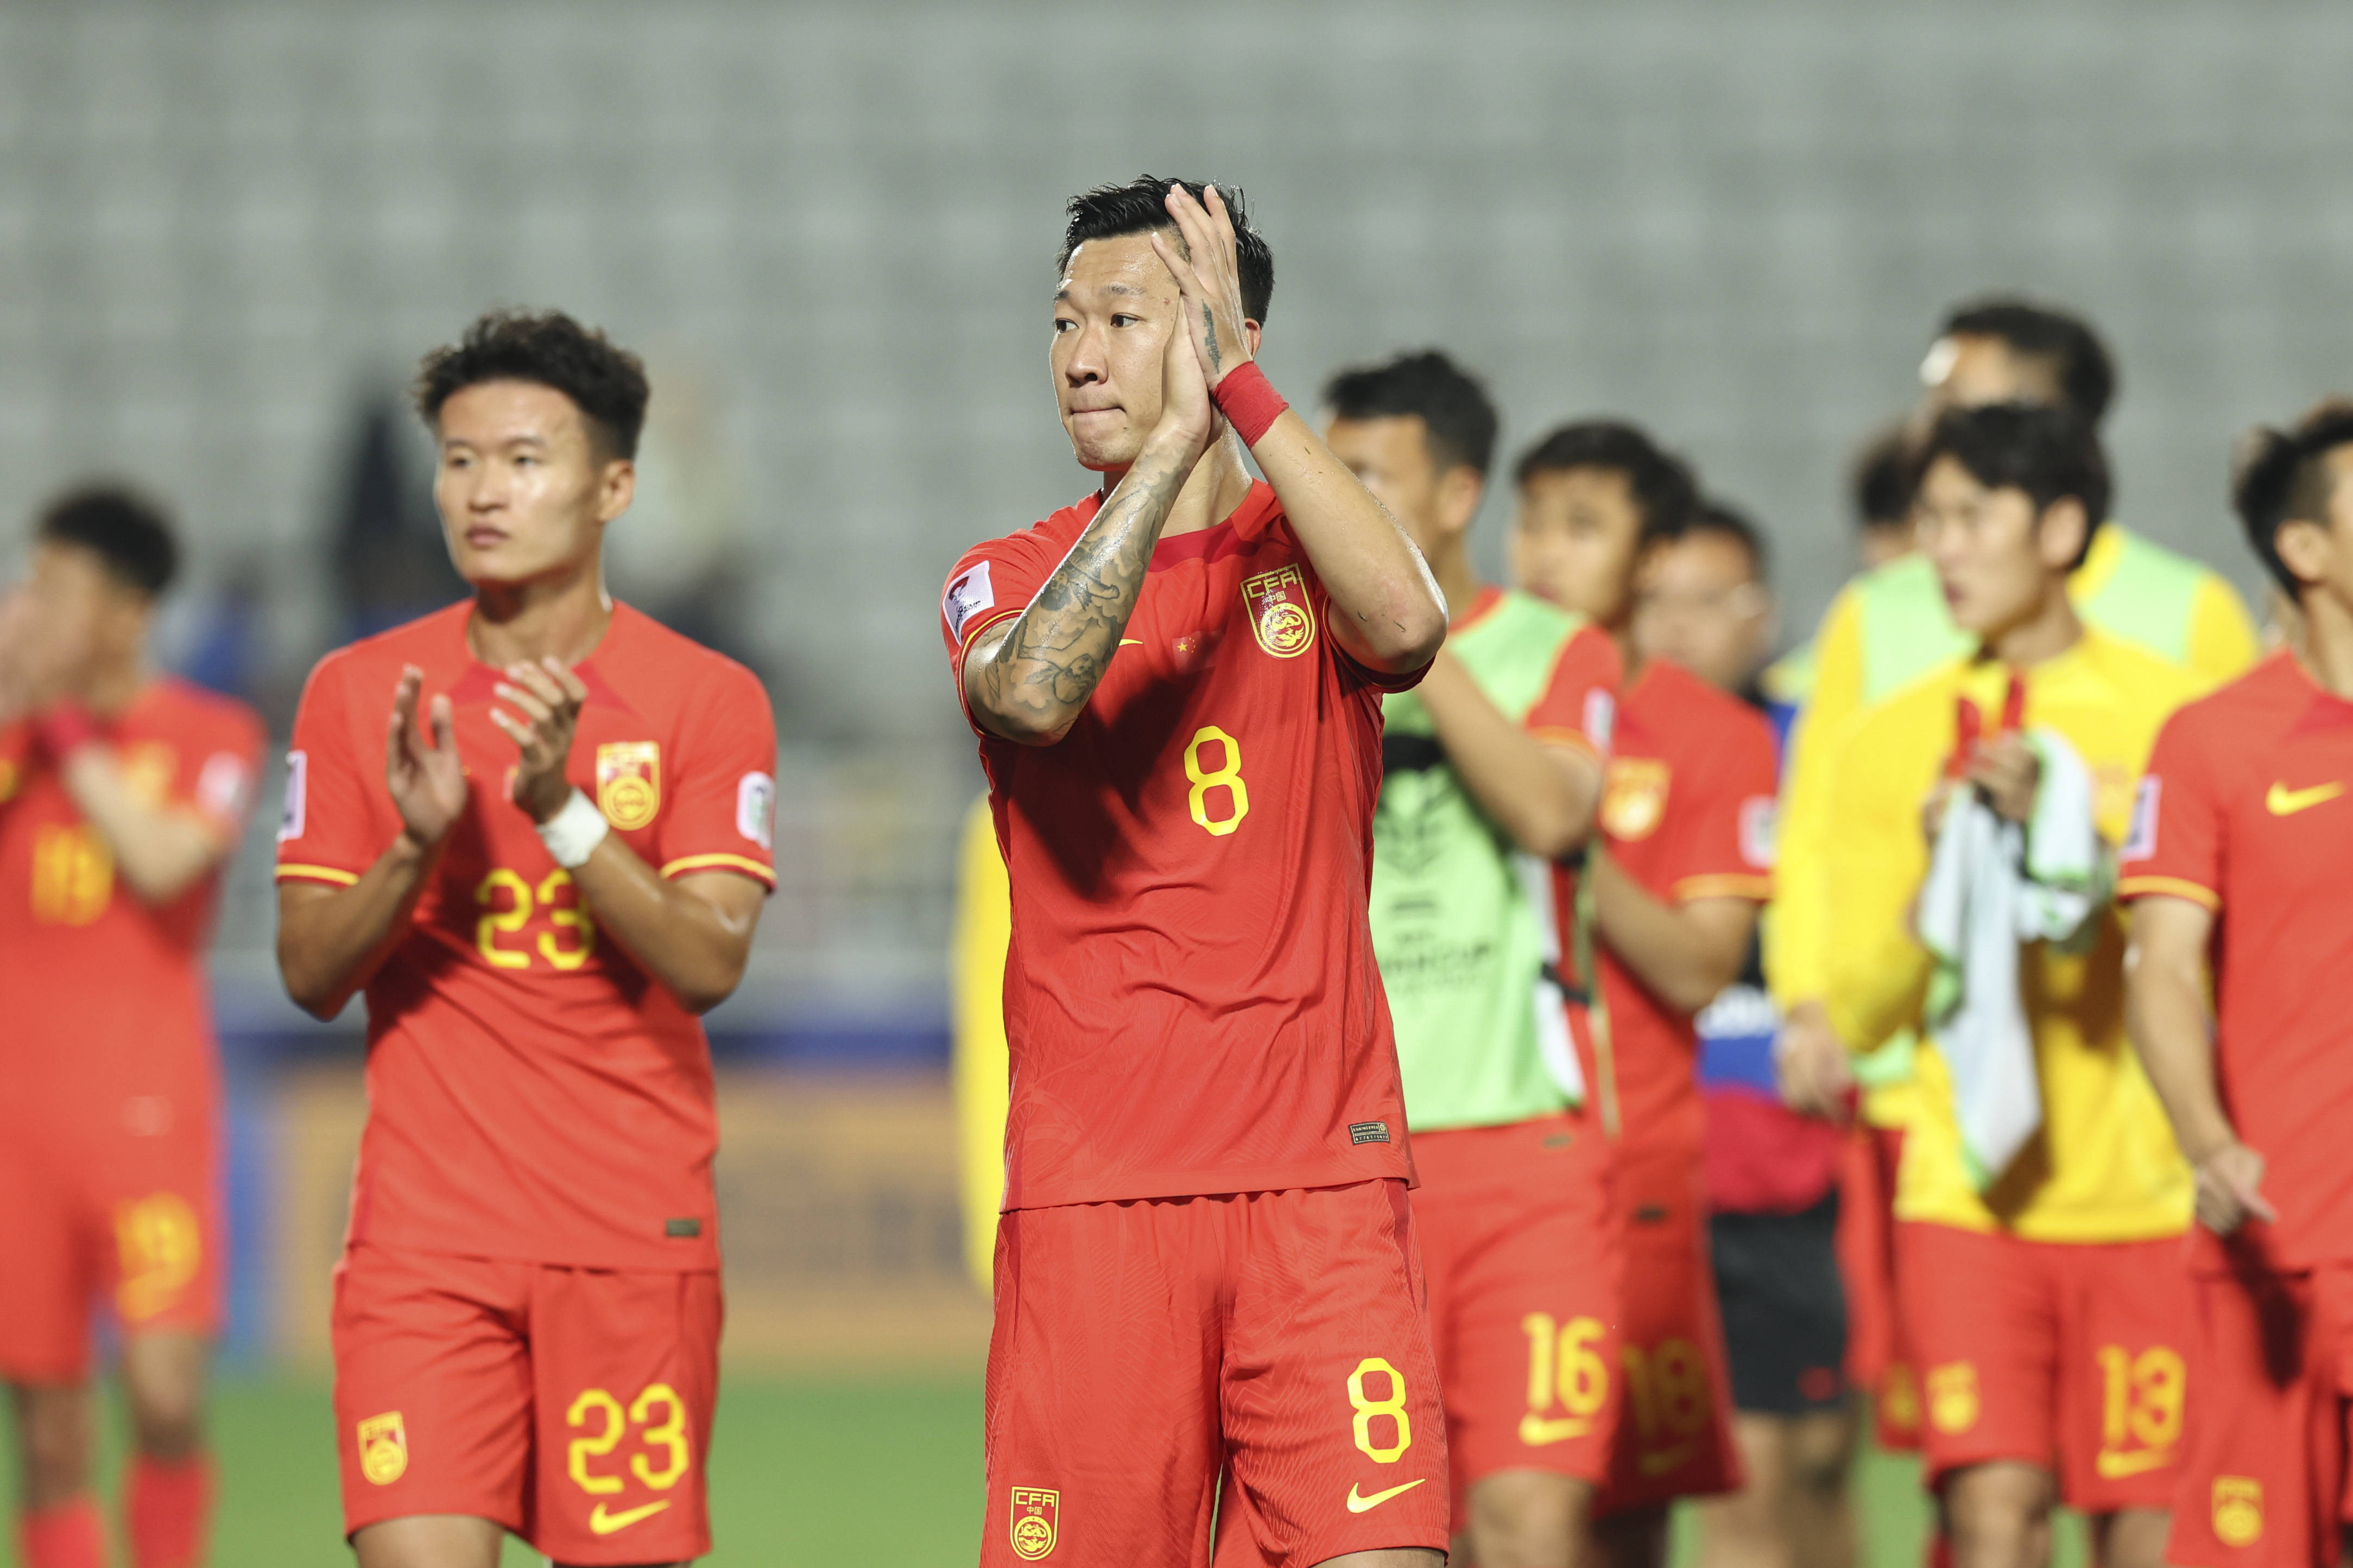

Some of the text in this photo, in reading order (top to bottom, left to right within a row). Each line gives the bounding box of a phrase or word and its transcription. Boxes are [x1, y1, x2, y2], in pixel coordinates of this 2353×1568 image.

[1247, 570, 1298, 599] CFA
[1184, 725, 1249, 836] 8
[476, 868, 594, 969] 23
[1346, 1357, 1412, 1464] 8
[1522, 1311, 1609, 1415] 16
[1621, 1337, 1710, 1436] 18
[2096, 1344, 2187, 1448] 13
[566, 1383, 690, 1495] 23
[1016, 1491, 1055, 1507] CFA
[1026, 1506, 1042, 1515] 中国
